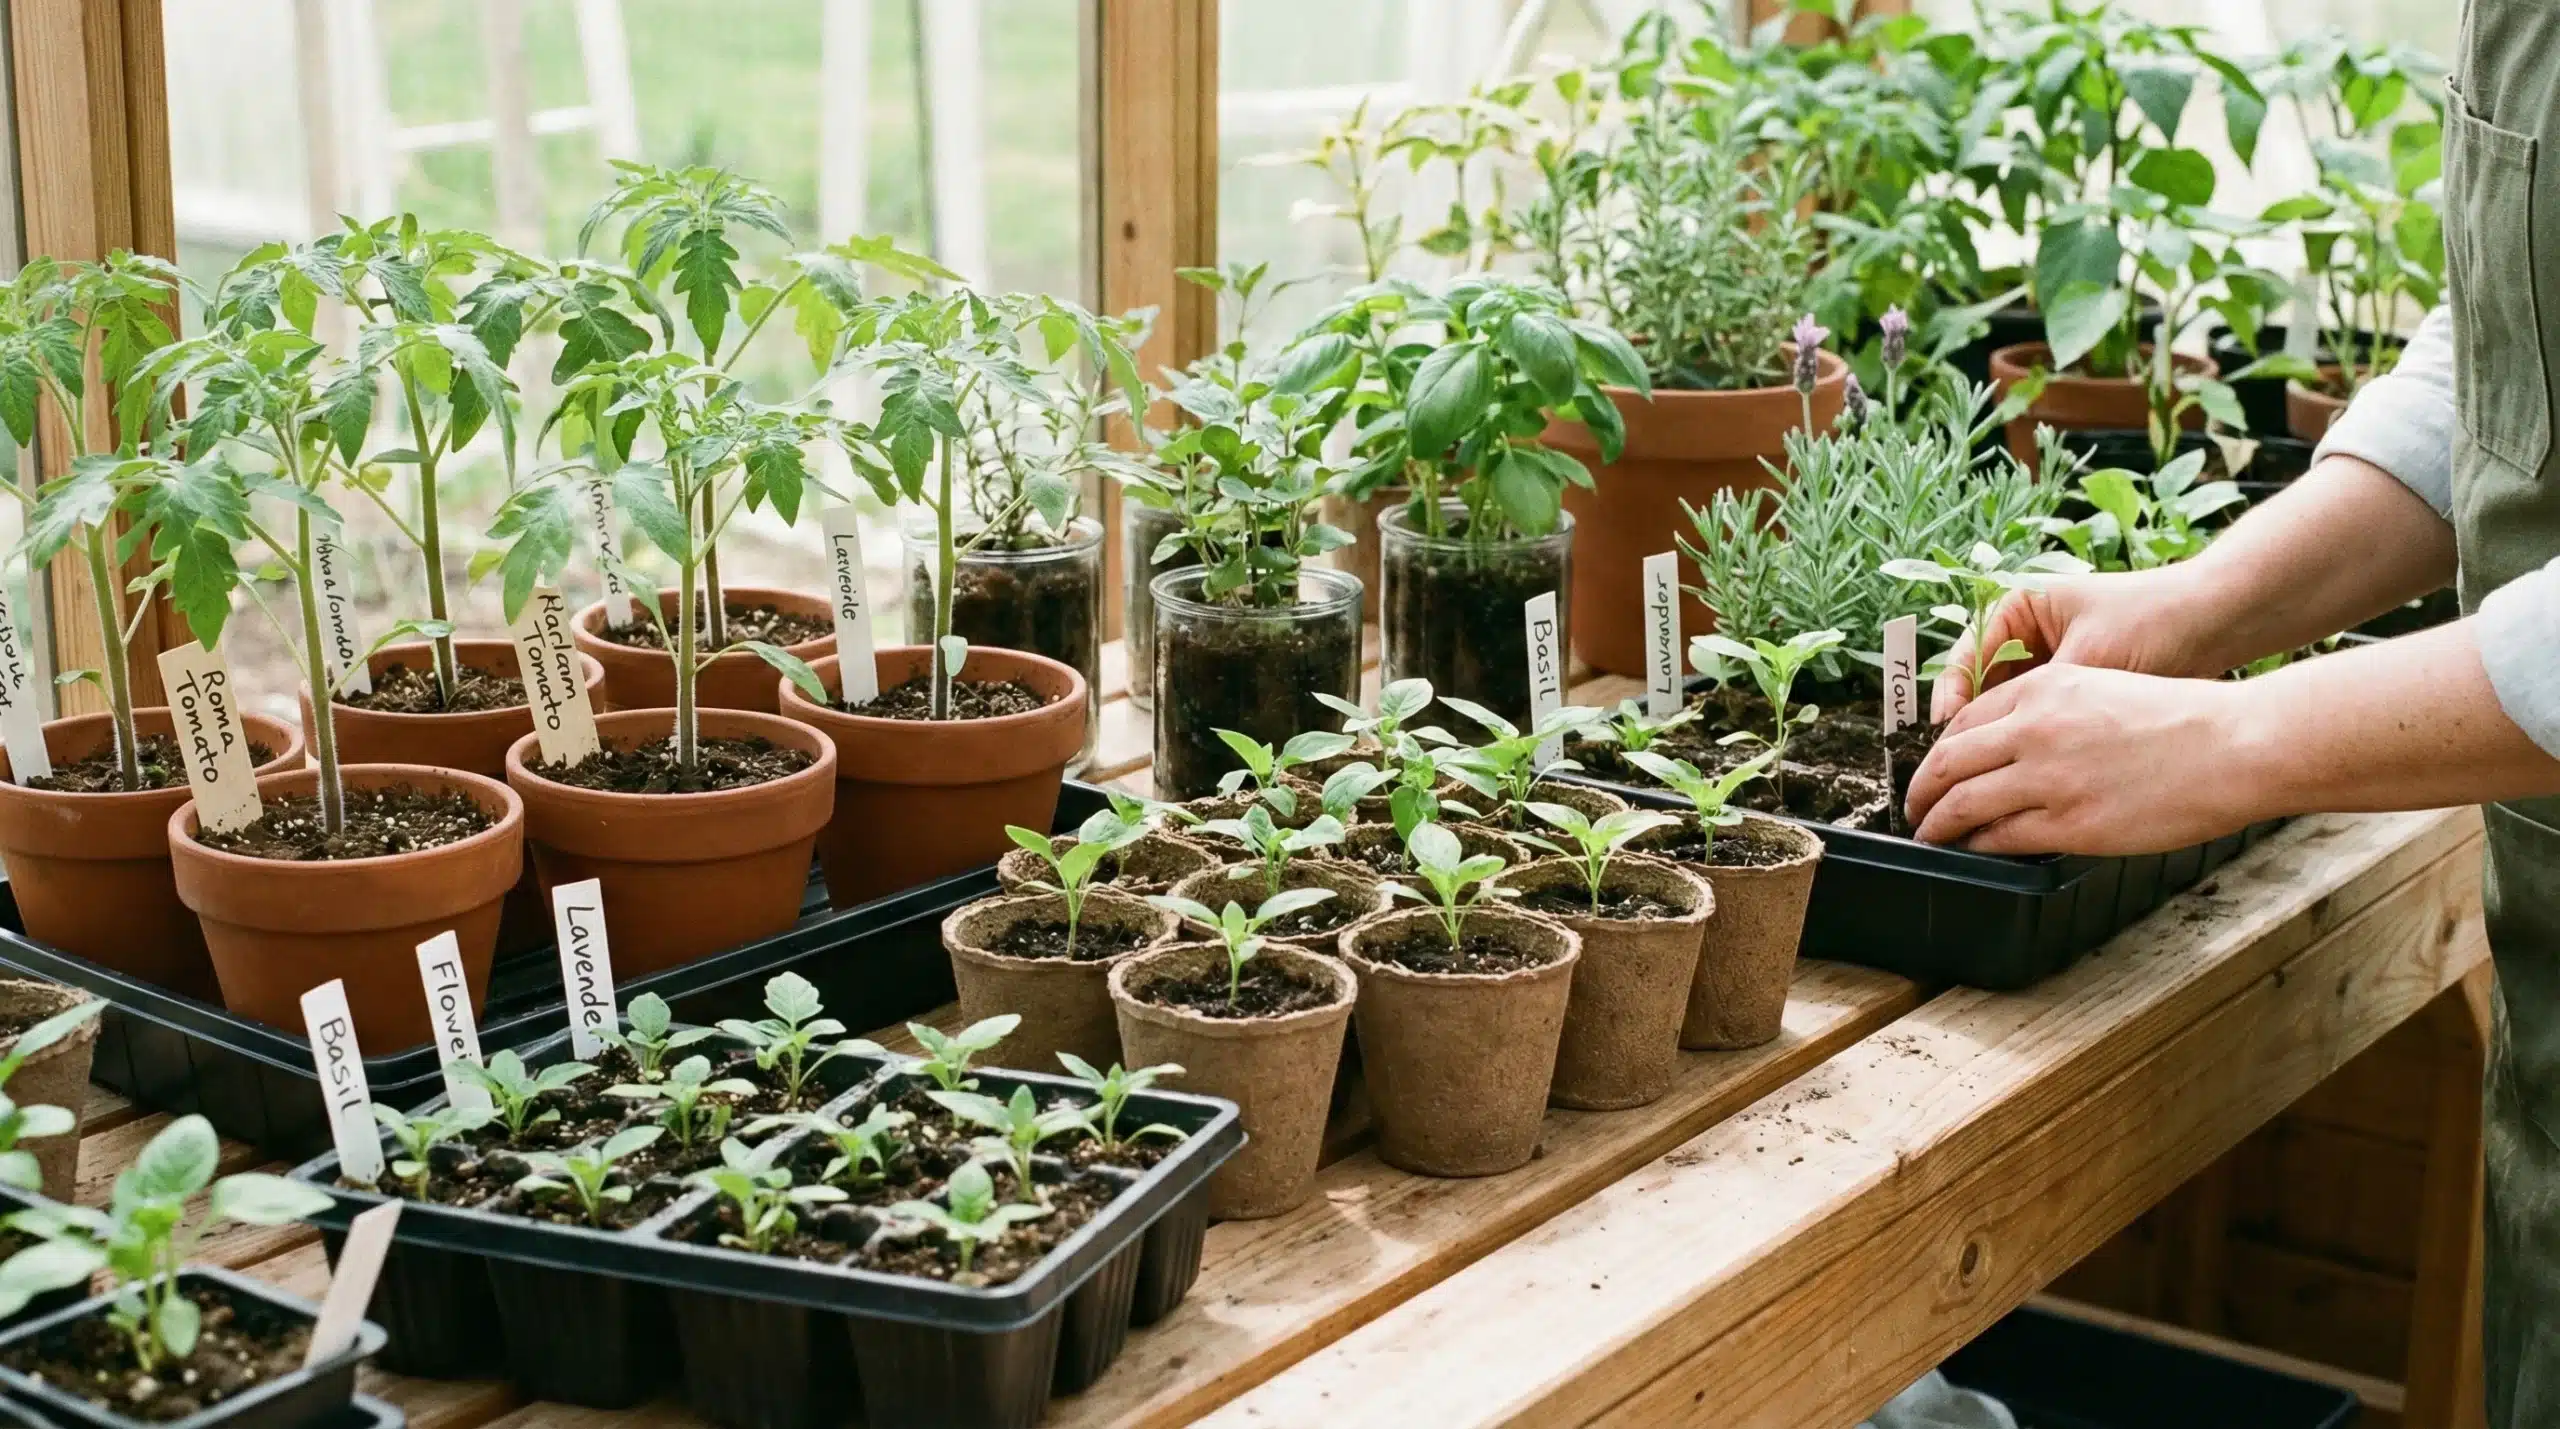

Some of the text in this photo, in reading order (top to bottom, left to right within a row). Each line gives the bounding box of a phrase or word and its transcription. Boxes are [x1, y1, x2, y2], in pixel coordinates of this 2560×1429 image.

[522, 620, 561, 731] Tomato
[1533, 619, 1556, 701] Basil
[176, 670, 218, 783] Tomato
[202, 670, 234, 754] Roma
[319, 1017, 362, 1113] Basil
